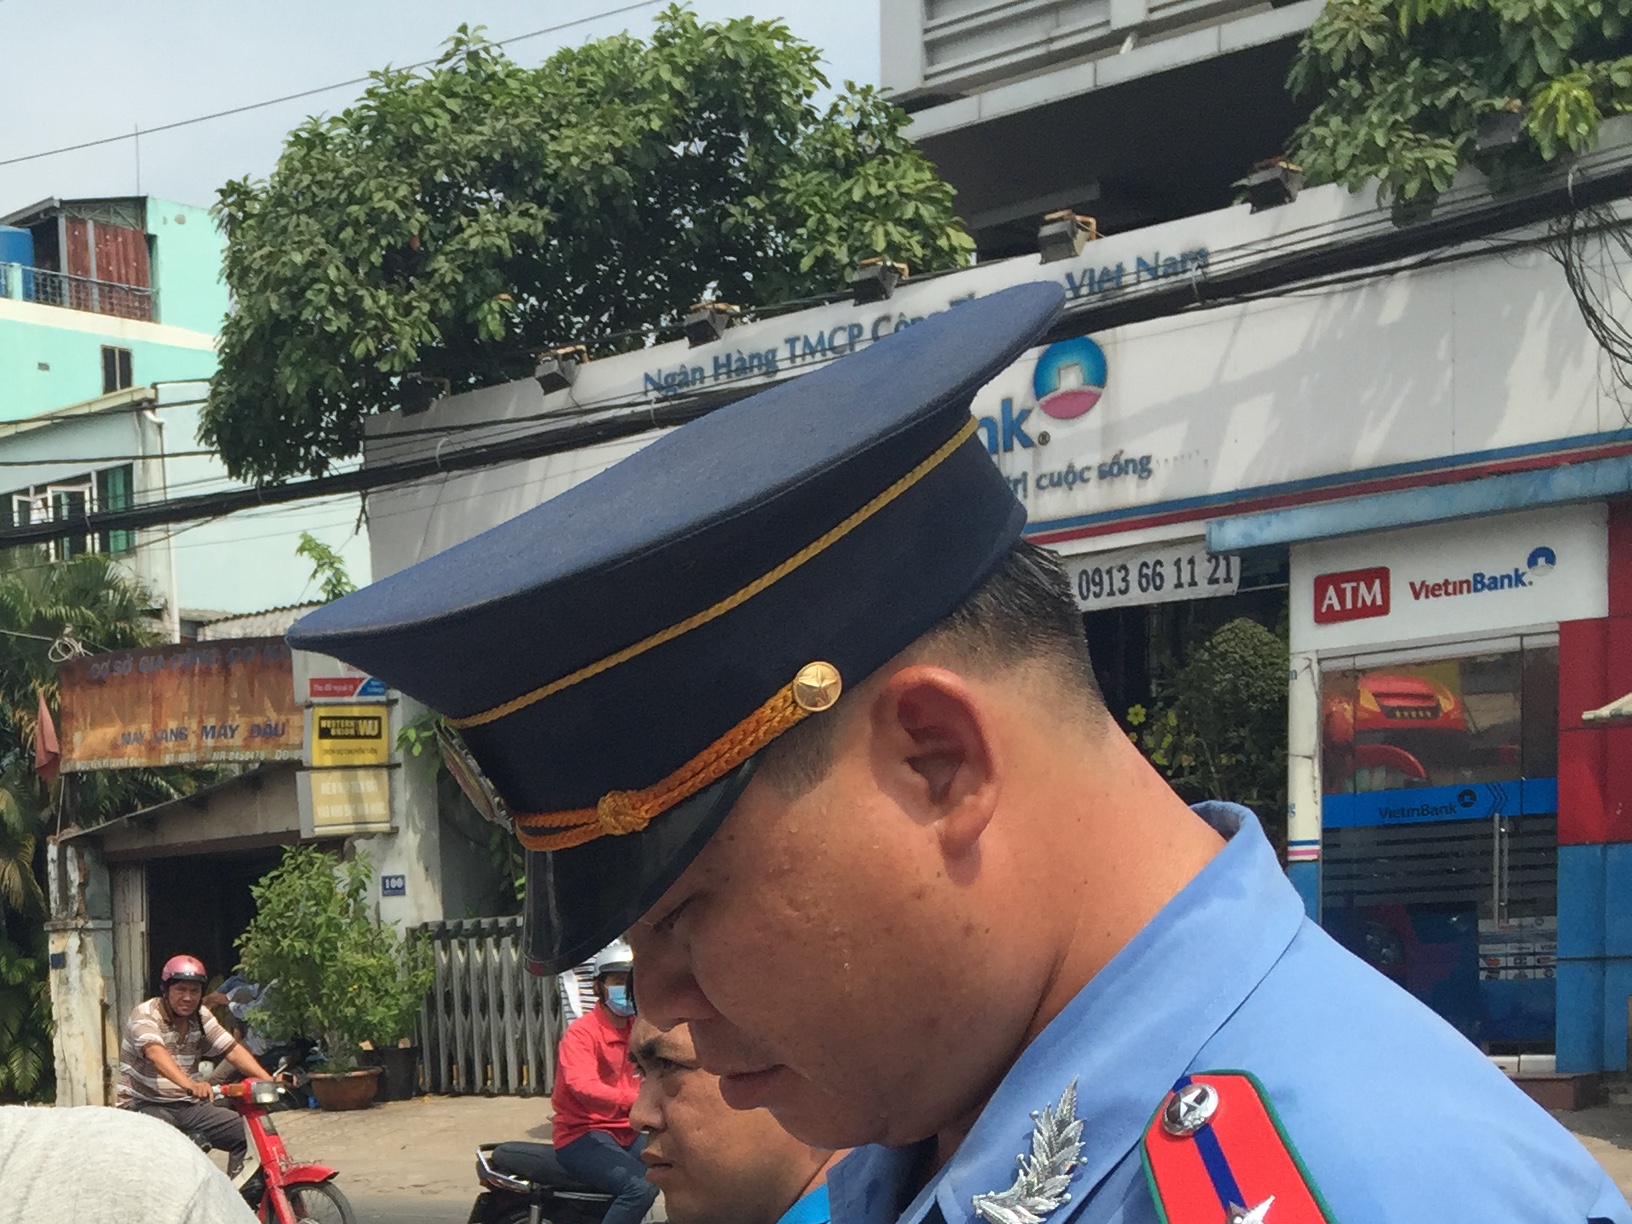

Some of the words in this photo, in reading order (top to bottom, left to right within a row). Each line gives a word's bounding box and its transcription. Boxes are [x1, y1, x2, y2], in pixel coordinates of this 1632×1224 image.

[643, 363, 705, 396] Ngân
[712, 348, 780, 382] Hàng
[784, 323, 864, 364] TMCP
[1035, 464, 1091, 490] cuộc
[1097, 449, 1153, 480] sống
[1078, 563, 1130, 600] 0913
[1137, 559, 1165, 593] 66
[1173, 556, 1199, 589] 11
[1206, 554, 1234, 585] 21
[1320, 577, 1383, 614] ATM
[385, 877, 404, 889] 100
